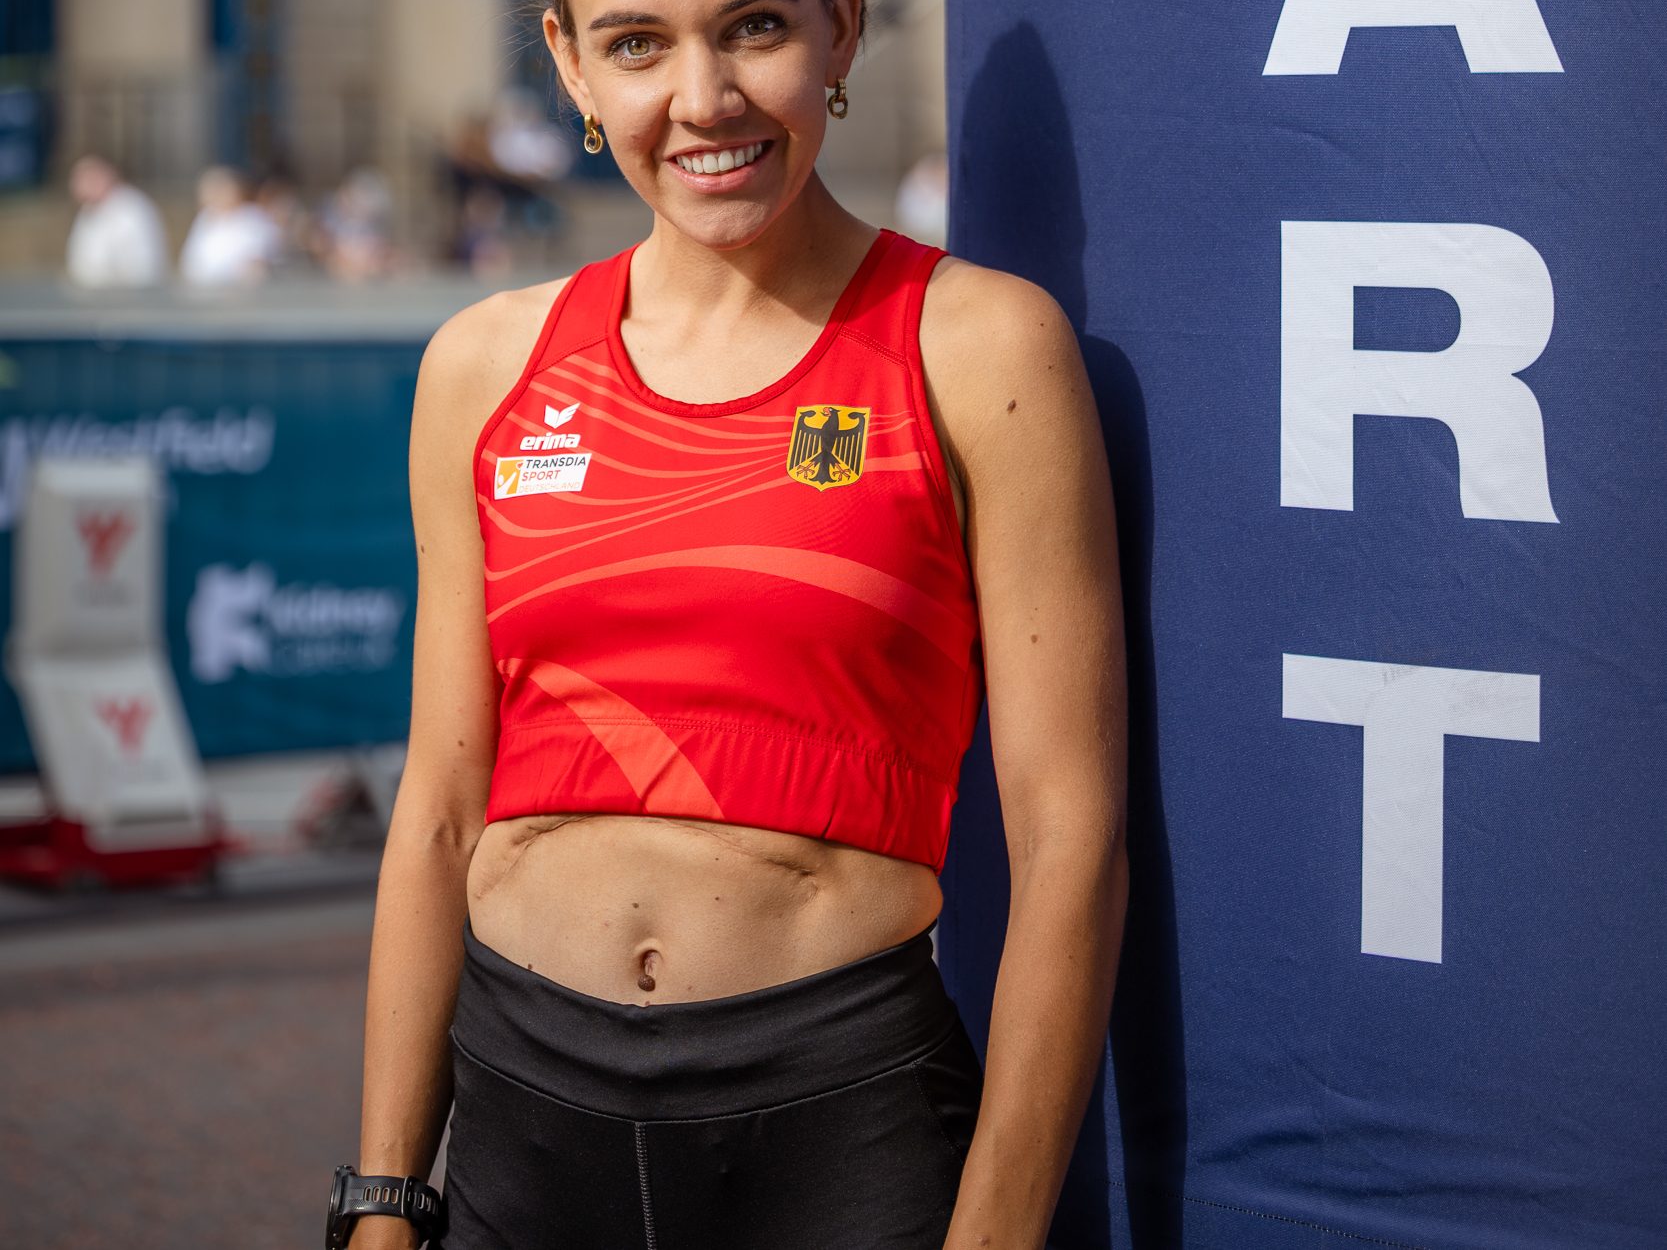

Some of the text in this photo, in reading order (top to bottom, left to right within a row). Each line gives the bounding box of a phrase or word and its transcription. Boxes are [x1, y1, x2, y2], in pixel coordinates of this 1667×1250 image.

[520, 432, 581, 451] erima
[525, 456, 586, 469] TRANSDIA
[521, 470, 561, 482] SPORT
